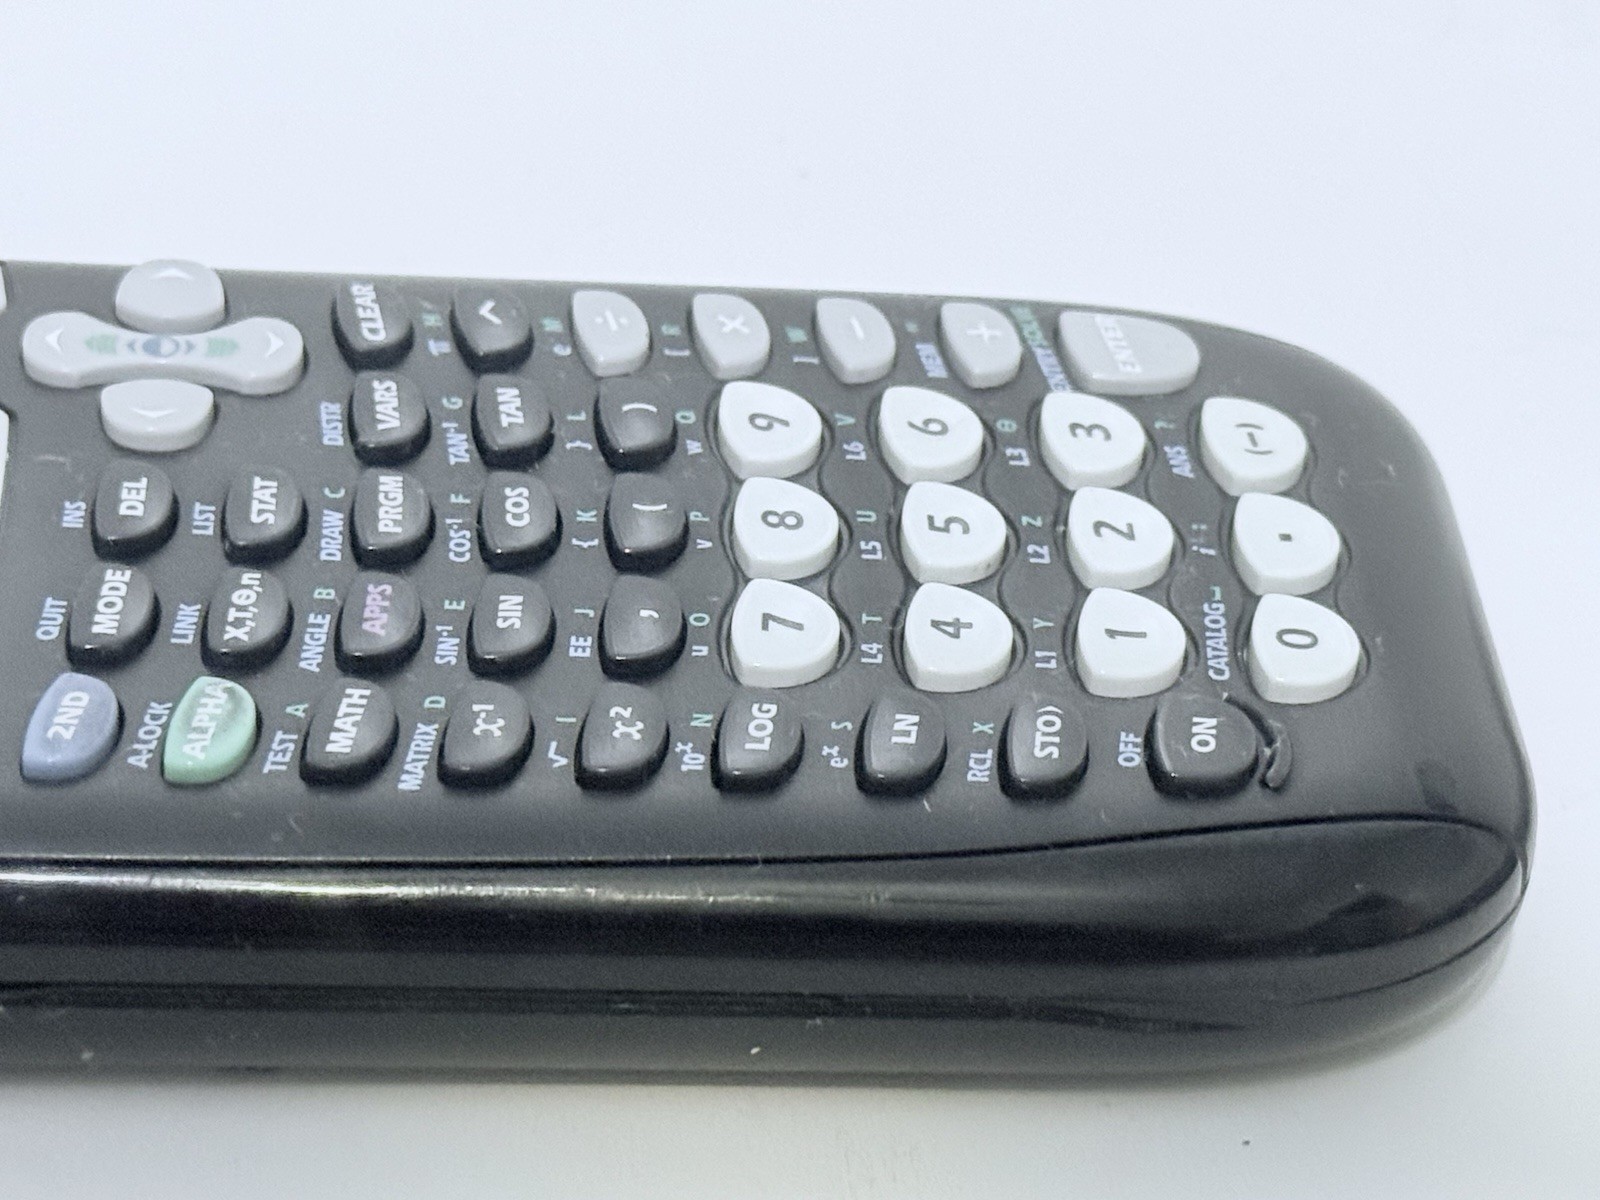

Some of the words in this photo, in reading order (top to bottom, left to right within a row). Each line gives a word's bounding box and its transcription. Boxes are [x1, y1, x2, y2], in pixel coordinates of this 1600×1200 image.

[351, 282, 386, 341] CLEAR
[372, 379, 400, 430] VARS
[442, 395, 463, 409] G
[496, 387, 524, 427] TAN
[320, 401, 344, 446] DISTR
[567, 410, 586, 421] L
[748, 412, 790, 431] 9
[835, 413, 856, 426] V
[907, 418, 949, 436] 6
[1068, 422, 1111, 442] 3
[1163, 445, 1195, 478] ANS
[119, 477, 148, 517] DEL
[250, 476, 278, 525] STAT
[323, 487, 345, 499] C
[450, 493, 471, 504] F
[62, 500, 87, 528] INS
[377, 476, 404, 533] PRGM
[504, 486, 530, 527] COS
[576, 509, 597, 522] K
[192, 502, 216, 535] LIST
[690, 511, 710, 522] P
[761, 510, 804, 530] 8
[856, 510, 877, 523] U
[926, 514, 970, 535] 5
[1021, 515, 1044, 528] Z
[320, 509, 345, 561] DRAW
[1092, 520, 1136, 541] 2
[860, 540, 883, 560] L5
[1027, 544, 1051, 564] L2
[92, 569, 132, 635] MODE
[313, 588, 336, 600] B
[444, 599, 465, 611] E
[36, 597, 68, 641] QUIT
[362, 584, 393, 635] APPS
[496, 595, 524, 629] SIN
[574, 608, 595, 618] J
[689, 613, 710, 626] O
[862, 613, 882, 624] T
[171, 603, 201, 644] LINK
[761, 612, 804, 631] 7
[930, 617, 973, 639] 4
[1033, 617, 1055, 629] Y
[299, 613, 331, 672] ANGLE
[1104, 628, 1147, 639] 1
[1203, 602, 1230, 681] CATALOG
[1276, 628, 1319, 649] 0
[569, 635, 593, 657] EE
[861, 642, 883, 664] L4
[285, 703, 309, 719] A
[423, 696, 446, 709] D
[46, 690, 90, 740] 2ND
[183, 682, 230, 759] ALPHA
[325, 688, 372, 754] MATH
[690, 713, 714, 727] N
[831, 720, 853, 731] S
[744, 702, 778, 751] LOG
[891, 713, 920, 745] LN
[972, 721, 995, 734] X
[1190, 716, 1218, 753] ON
[263, 730, 299, 773] TEST
[398, 722, 440, 791] MATRIX
[1117, 731, 1143, 768] OFF
[967, 748, 993, 783] RCL
